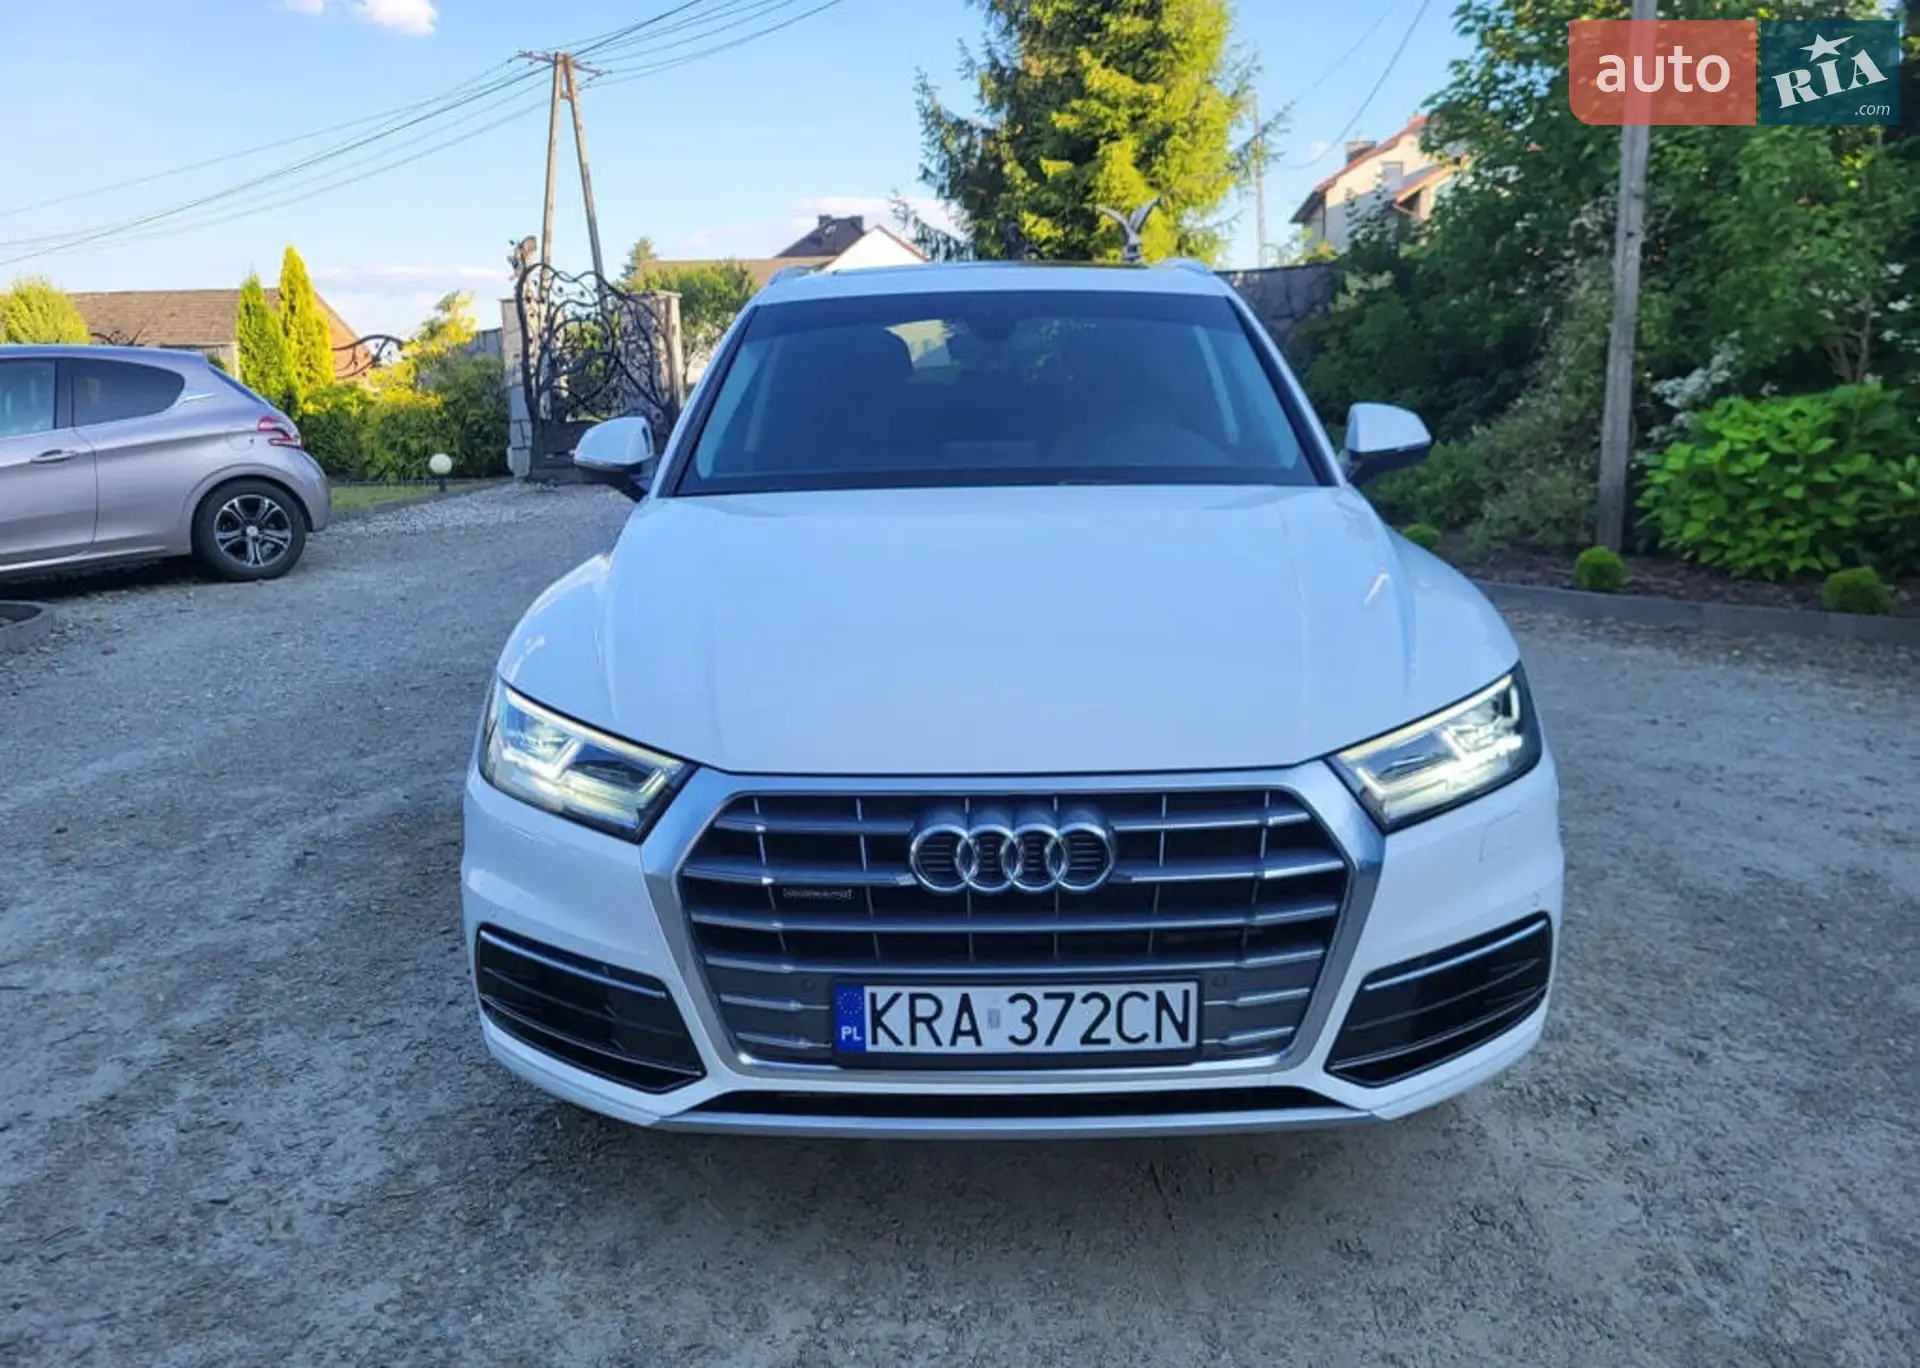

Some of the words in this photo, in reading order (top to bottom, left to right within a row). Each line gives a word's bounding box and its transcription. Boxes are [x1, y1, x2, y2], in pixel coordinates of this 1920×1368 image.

[840, 1025, 863, 1041] PL
[869, 991, 983, 1047] KRA
[1007, 989, 1191, 1046] 372CN
